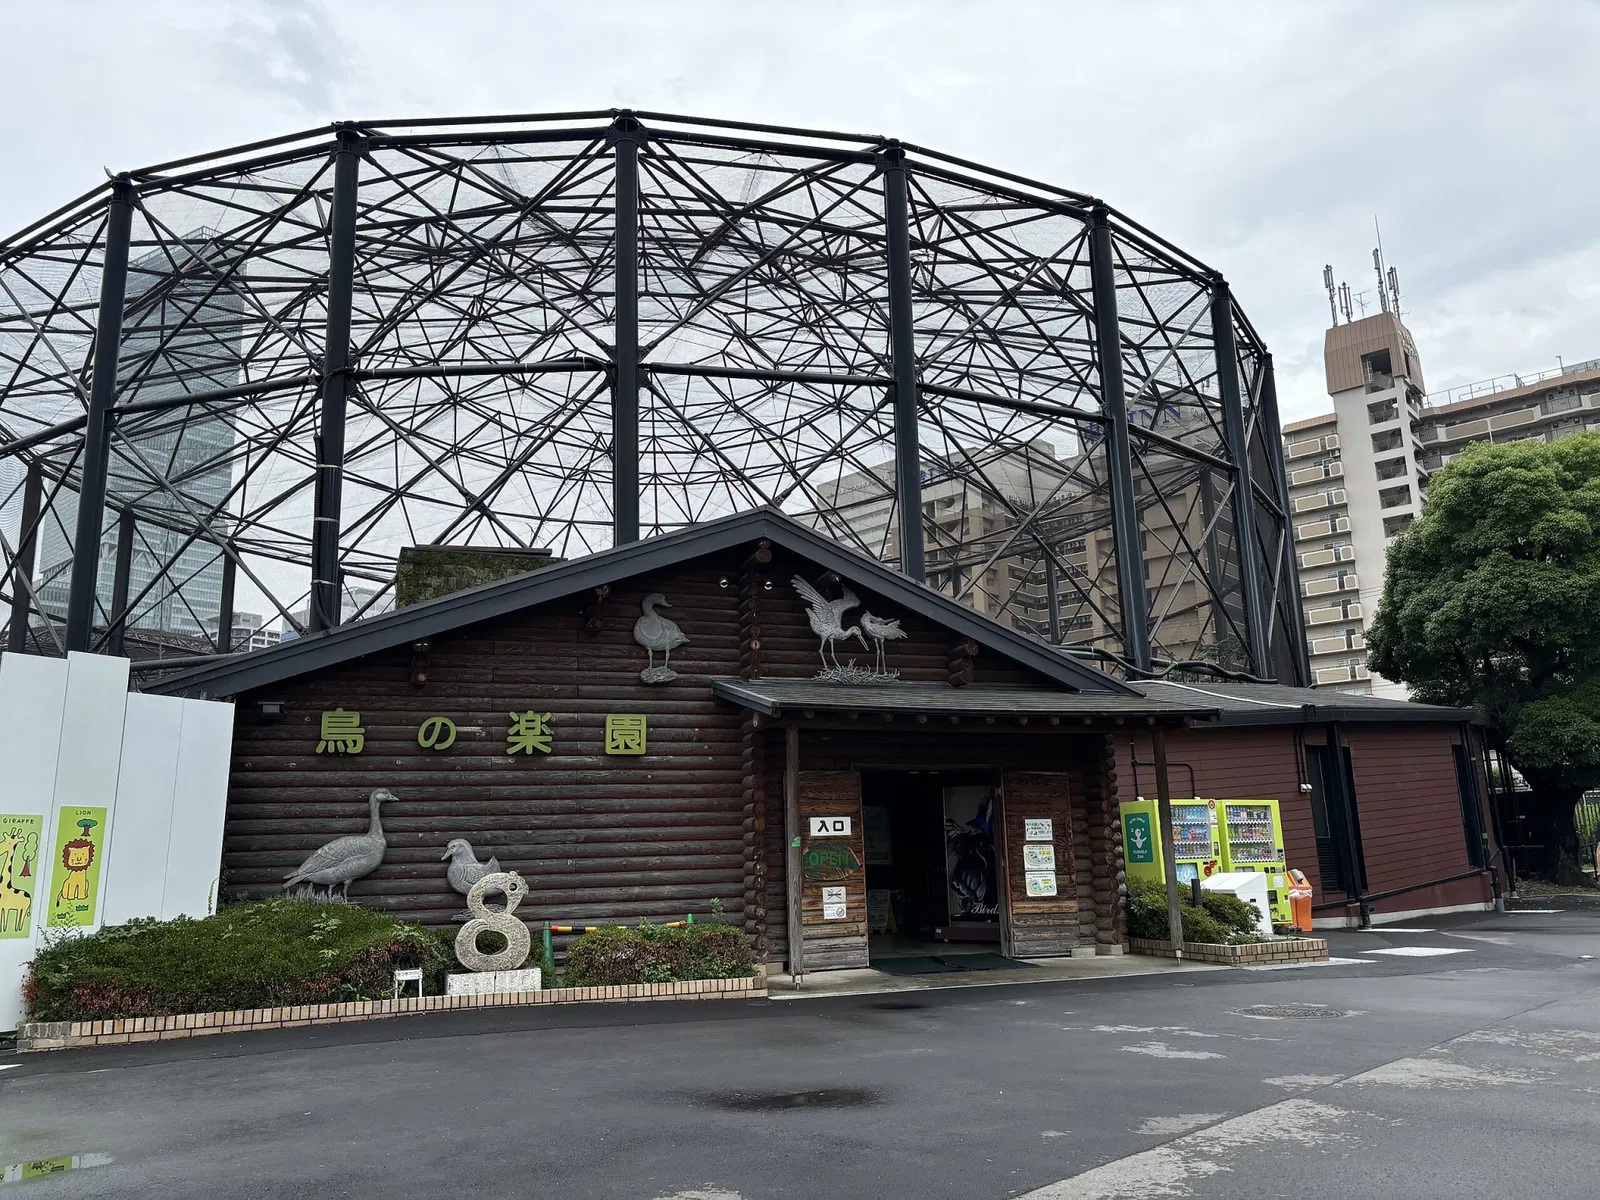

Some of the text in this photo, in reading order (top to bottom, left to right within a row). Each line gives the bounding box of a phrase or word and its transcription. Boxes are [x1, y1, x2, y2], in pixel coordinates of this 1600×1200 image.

[315, 707, 648, 756] 鳥の楽園
[817, 820, 845, 833] 入口
[809, 851, 850, 867] OPEN
